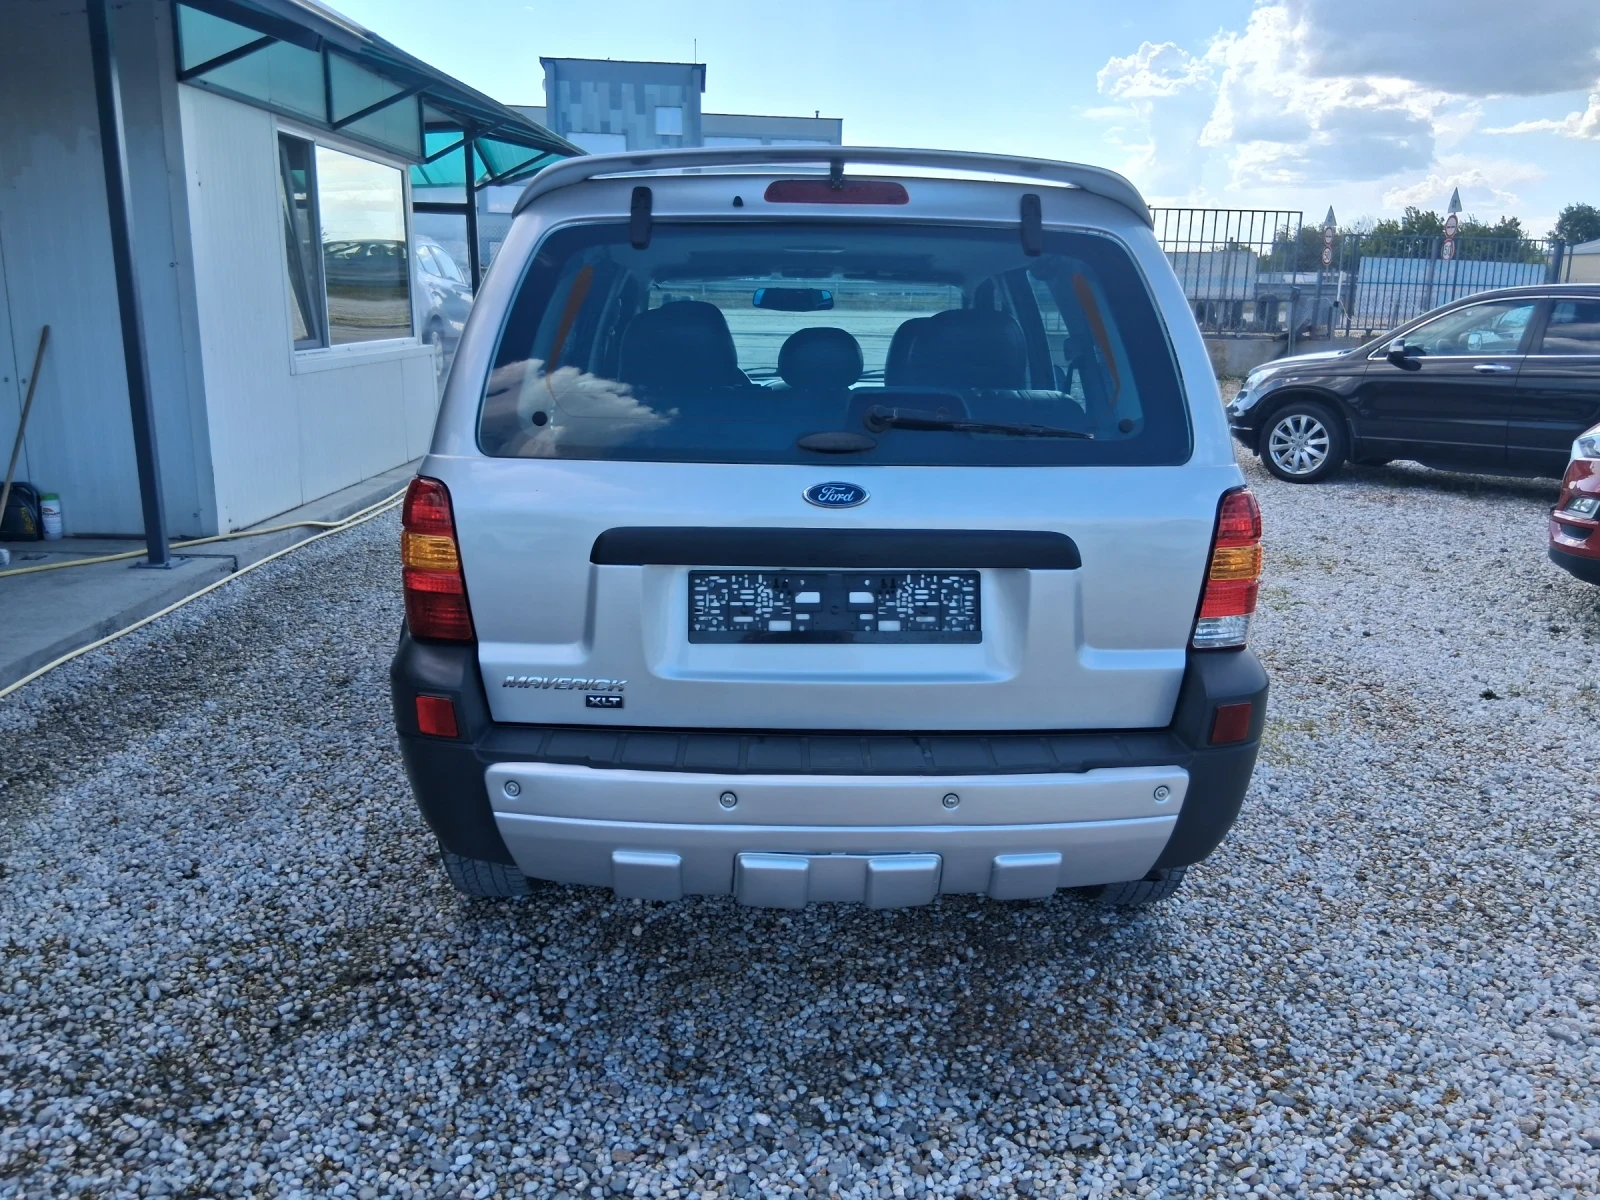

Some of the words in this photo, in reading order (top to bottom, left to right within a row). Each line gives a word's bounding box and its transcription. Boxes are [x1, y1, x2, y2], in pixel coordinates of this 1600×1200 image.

[818, 486, 855, 502] Ford
[502, 675, 628, 692] MAVERICK
[588, 697, 620, 706] XLT
